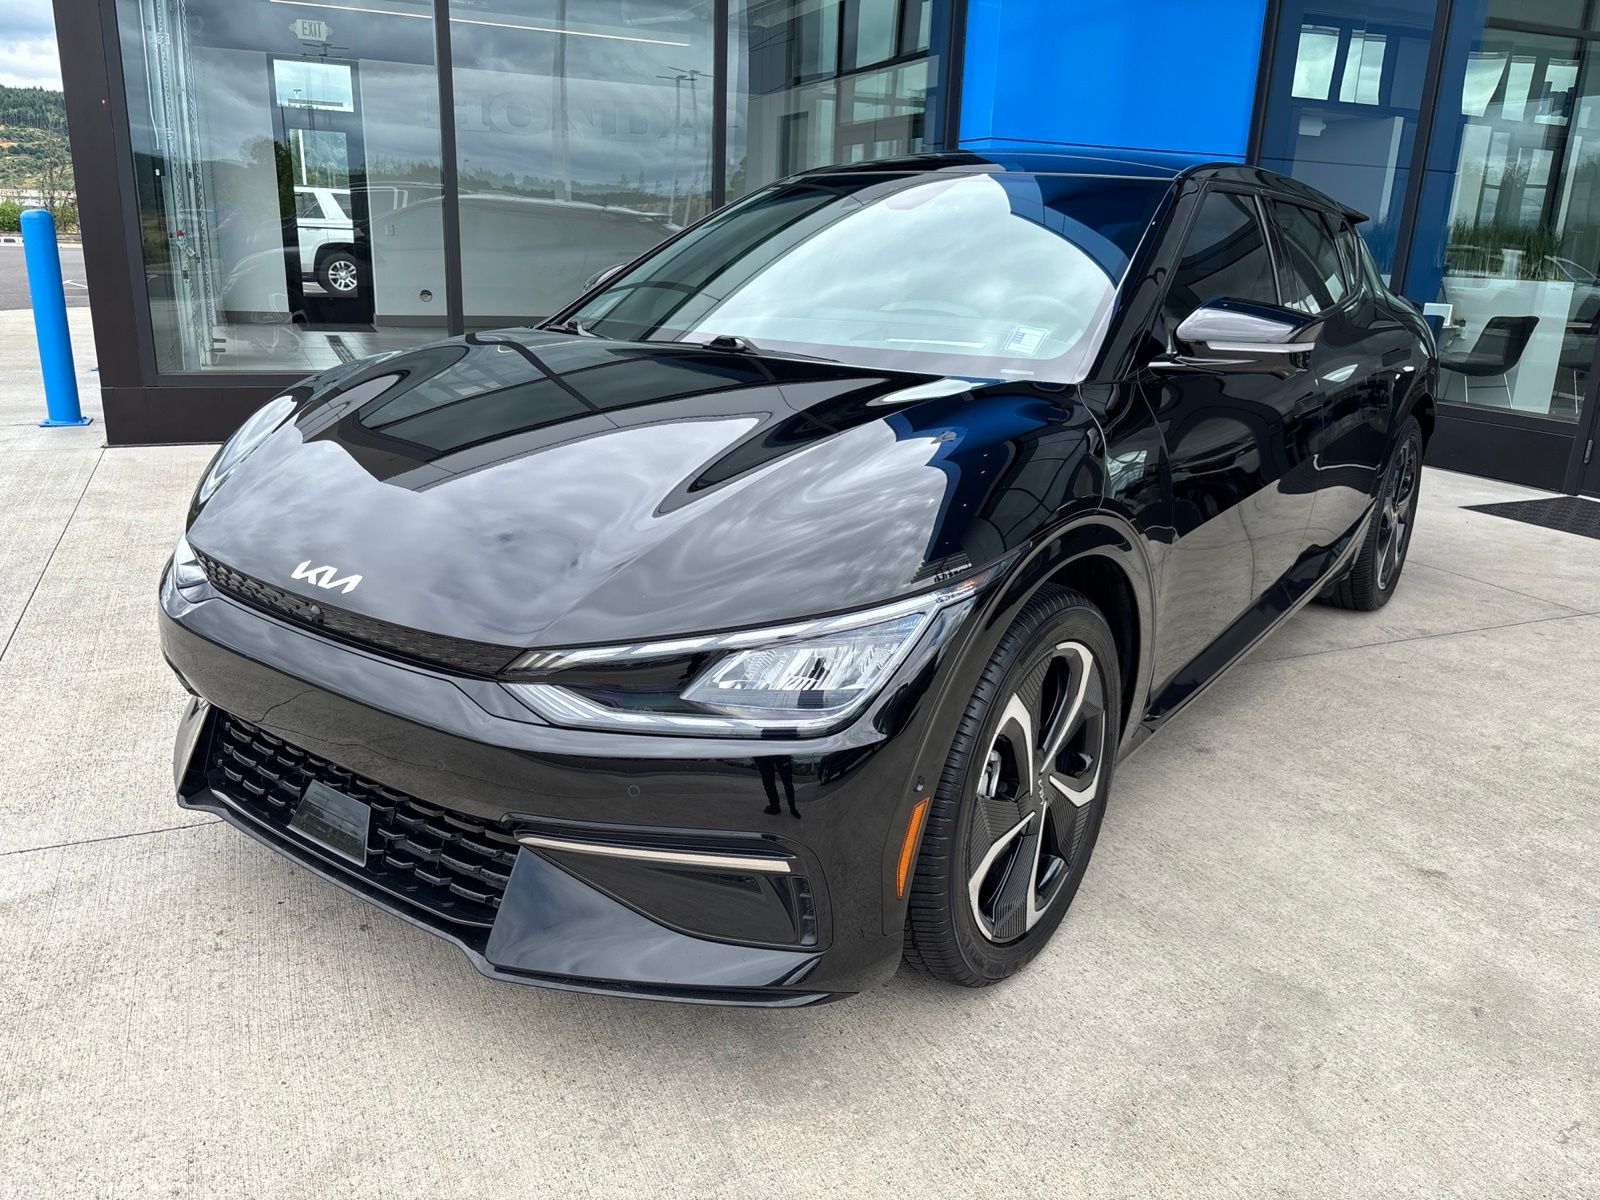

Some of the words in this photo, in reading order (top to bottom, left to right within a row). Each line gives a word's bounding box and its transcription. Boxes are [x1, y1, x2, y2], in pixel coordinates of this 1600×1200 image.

[301, 20, 322, 38] EXIT
[423, 87, 717, 145] HONDA
[290, 559, 363, 594] KIA
